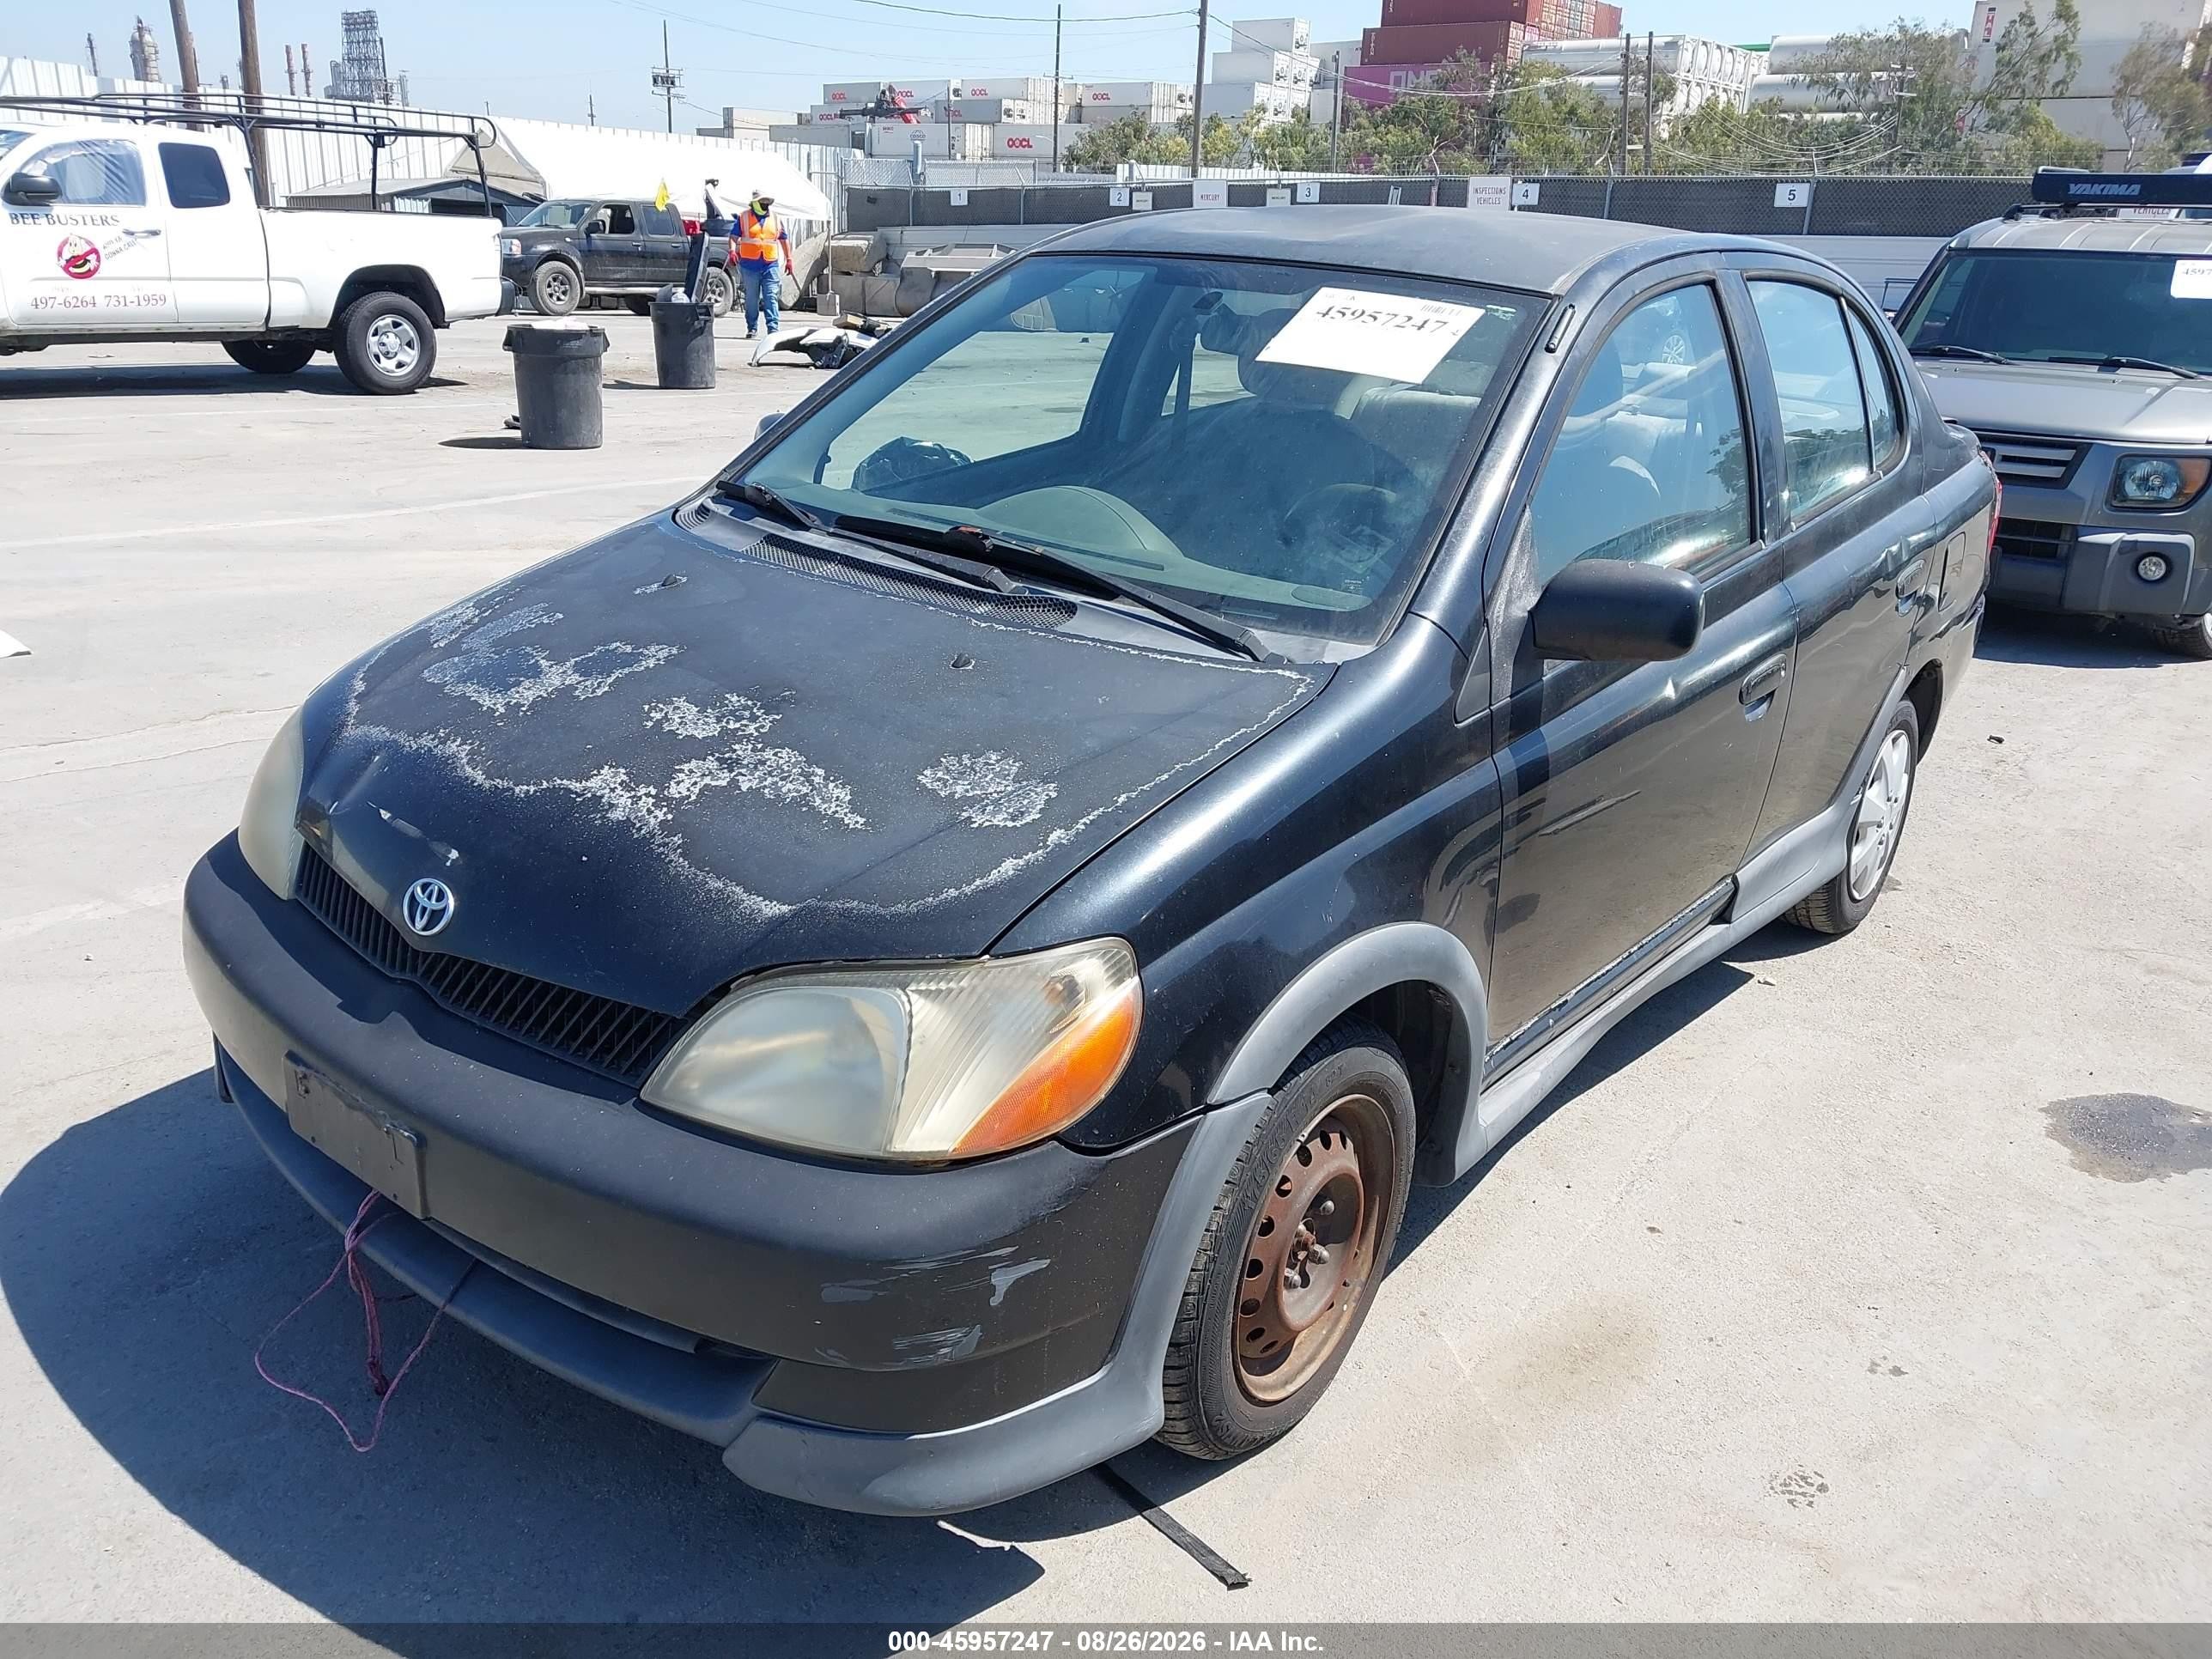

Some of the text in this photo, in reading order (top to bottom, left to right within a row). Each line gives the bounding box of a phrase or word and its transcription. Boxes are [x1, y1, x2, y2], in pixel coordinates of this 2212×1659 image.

[831, 92, 847, 100] OOCL
[971, 88, 988, 96] OOCL
[1092, 92, 1110, 100] OOCL
[819, 112, 834, 121] OOCL
[1006, 137, 1033, 149] OOCL
[1304, 186, 1311, 198] 3
[1473, 186, 1506, 195] INSPECTIONS
[1522, 189, 1529, 199] 4
[2068, 183, 2142, 195] YAKIMA
[1116, 191, 1122, 202] 2
[1200, 193, 1220, 202] MERCURY
[1787, 189, 1796, 201] 5
[1476, 197, 1501, 205] VEHICLES
[9, 212, 120, 226] BEE BUSTERS
[30, 294, 167, 310] 497-6264 731-1959
[1316, 305, 1449, 333] 45957247
